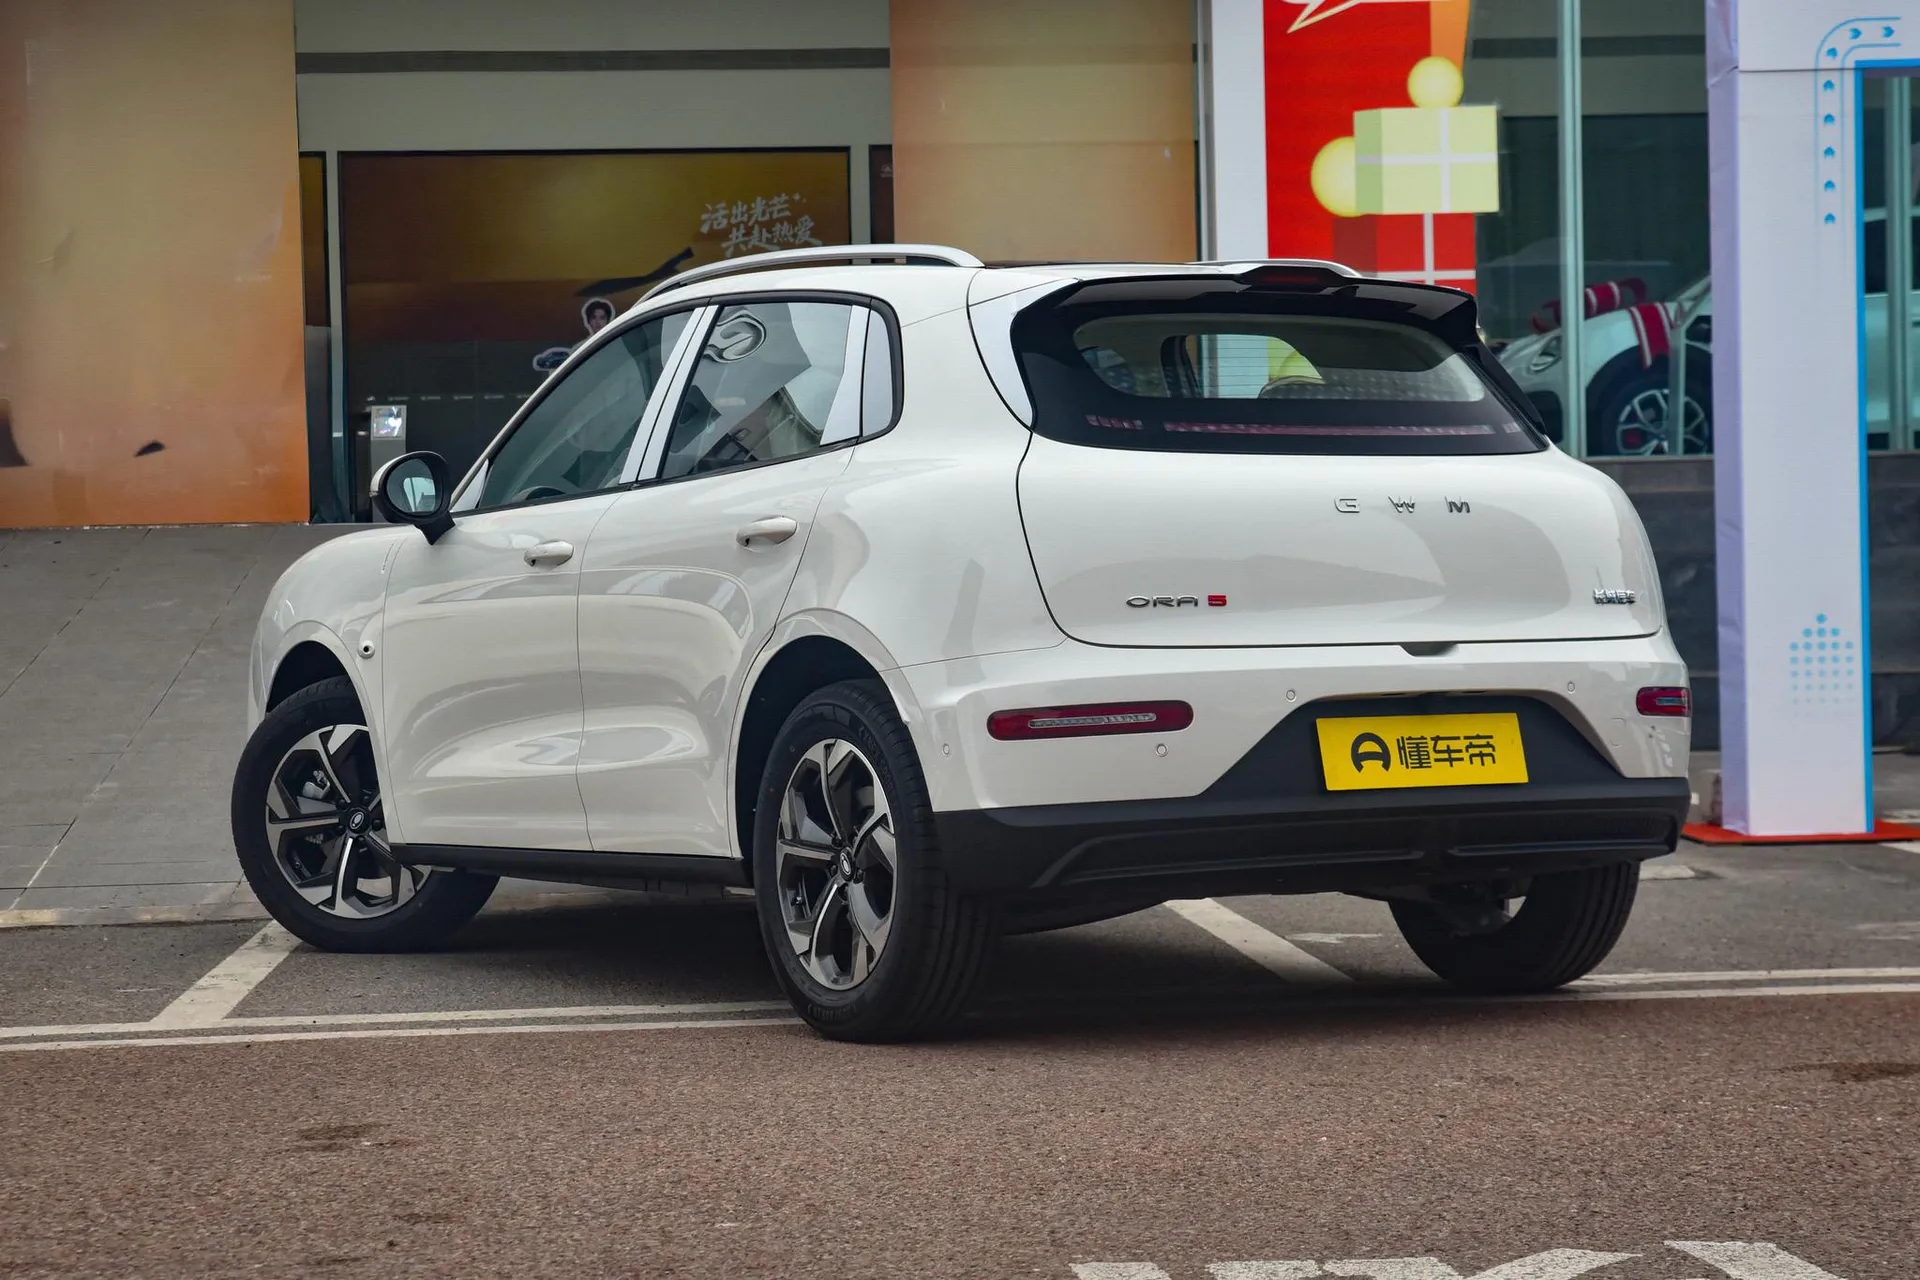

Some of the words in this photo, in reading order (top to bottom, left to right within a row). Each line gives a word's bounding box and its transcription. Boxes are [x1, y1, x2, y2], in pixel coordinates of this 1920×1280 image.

[700, 193, 791, 234] 活出光芒
[721, 214, 823, 258] 共赴热爱
[1126, 595, 1198, 608] ORA
[1207, 594, 1227, 607] 5
[1396, 734, 1496, 769] 懂车帝
